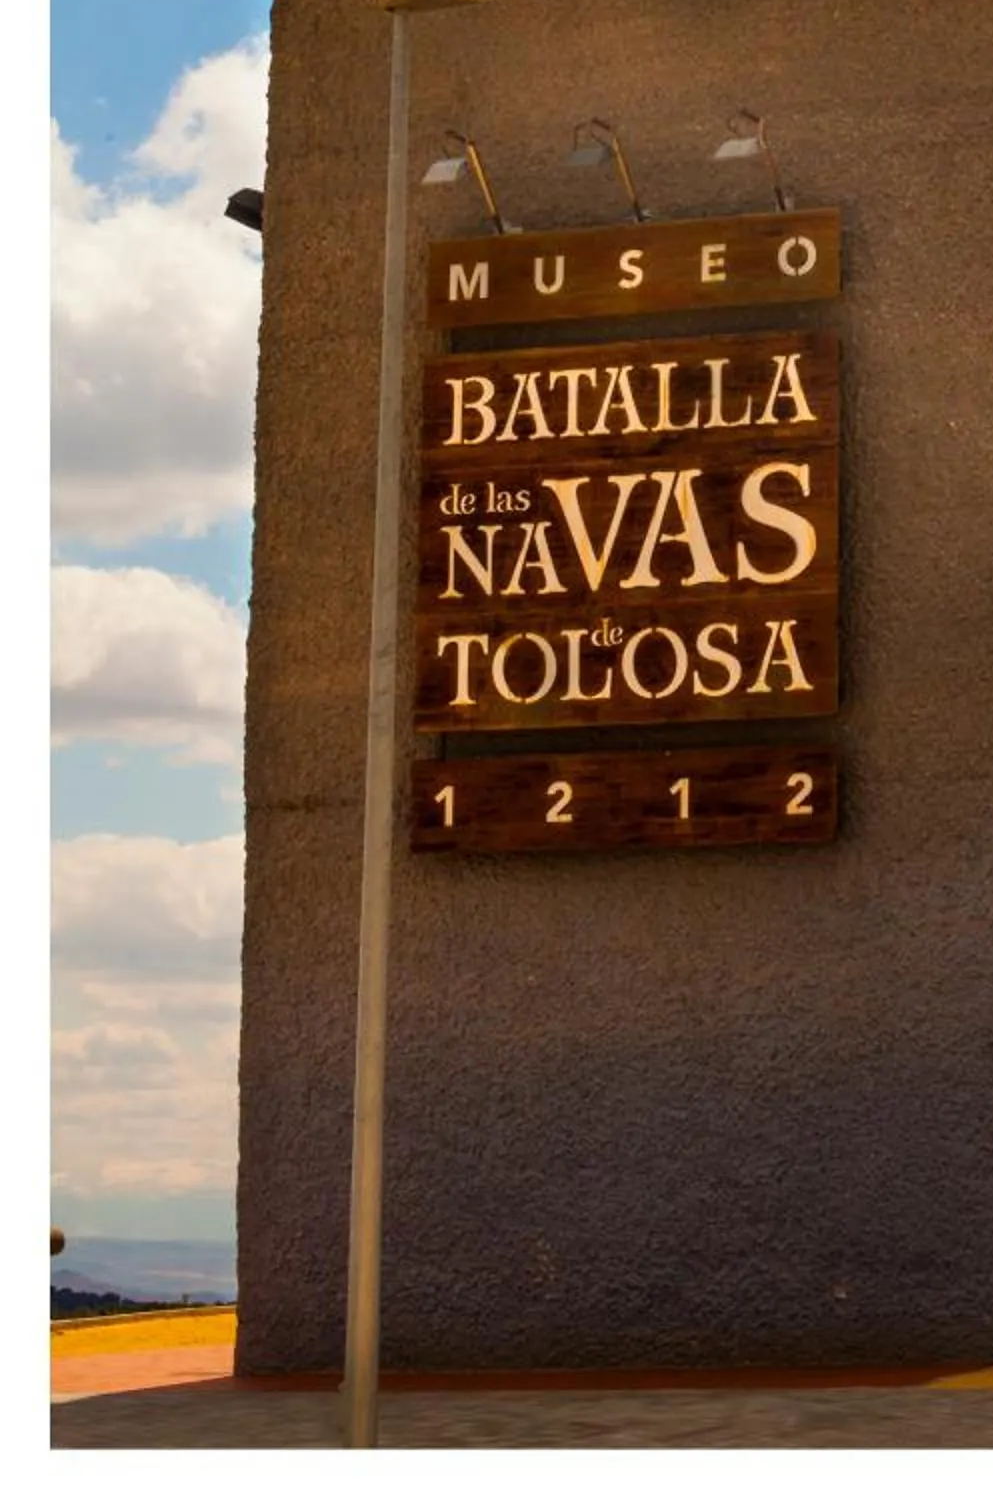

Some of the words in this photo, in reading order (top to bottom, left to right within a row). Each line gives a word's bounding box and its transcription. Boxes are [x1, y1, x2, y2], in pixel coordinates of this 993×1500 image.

[448, 236, 817, 300] MUSEO
[444, 354, 817, 446] BATALLA
[438, 462, 818, 598] NAVAS
[439, 484, 476, 516] de
[486, 482, 531, 513] las
[437, 619, 814, 705] TOLOSA
[590, 618, 623, 648] de
[434, 773, 814, 827] 1212
